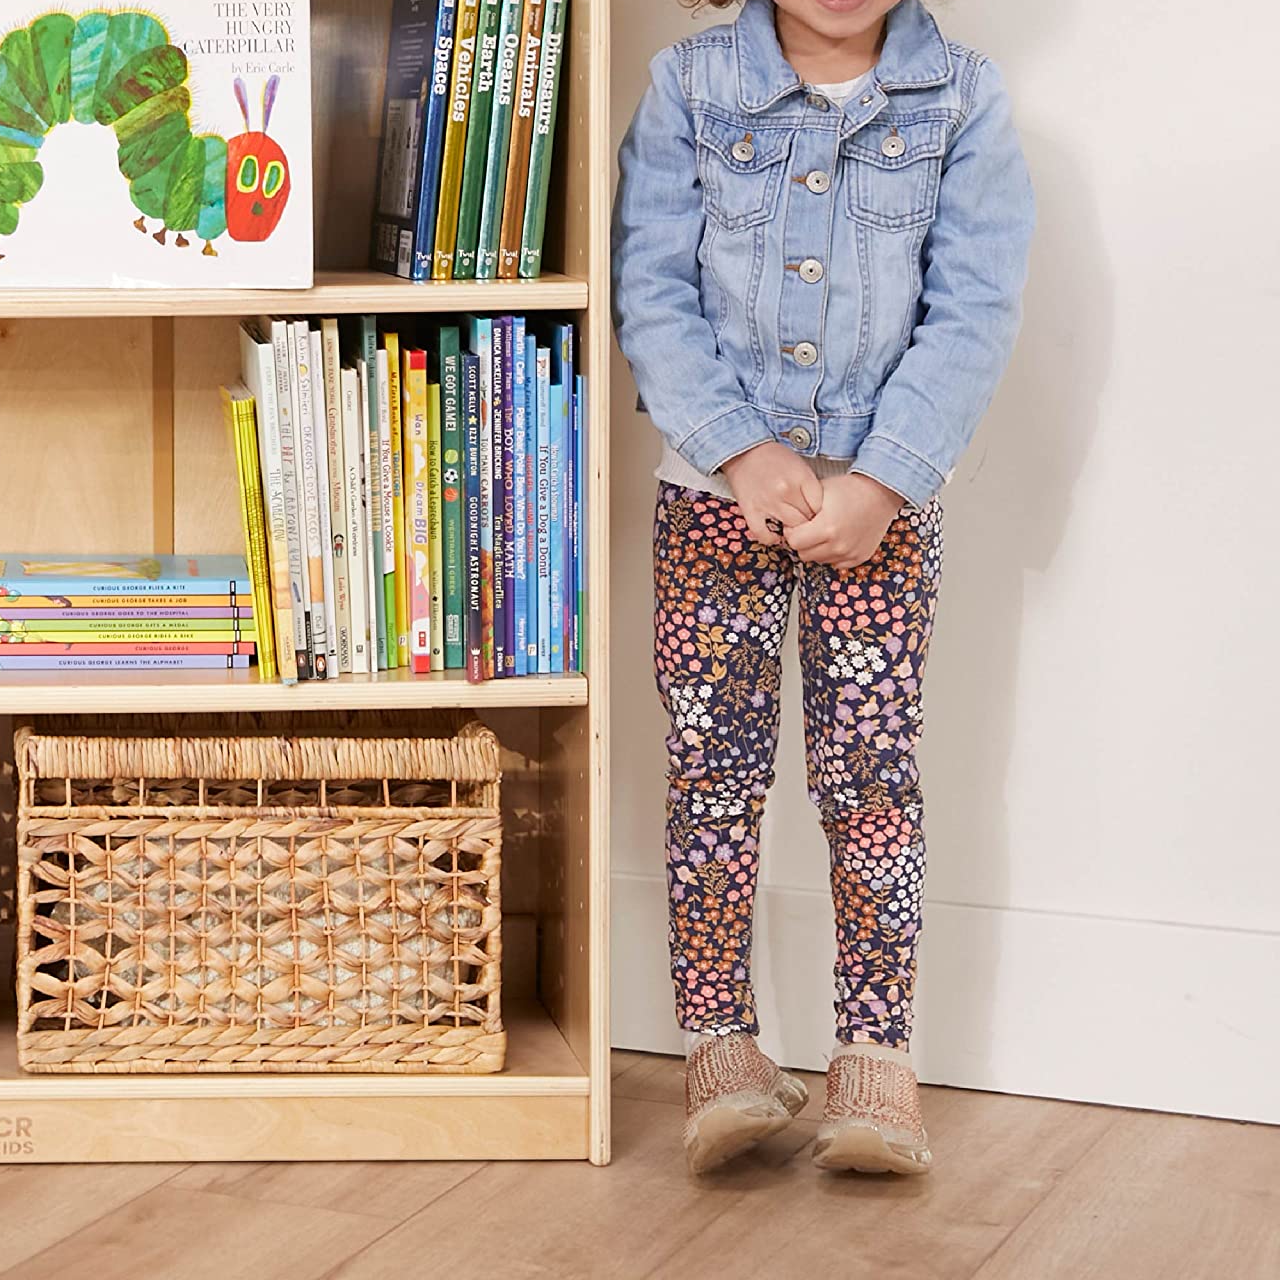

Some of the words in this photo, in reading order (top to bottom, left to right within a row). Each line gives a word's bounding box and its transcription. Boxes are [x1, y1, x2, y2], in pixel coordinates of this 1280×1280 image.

[213, 2, 248, 17] THE
[252, 2, 295, 17] VERY
[226, 20, 294, 35] HUNGRY
[183, 38, 295, 54] CATERPILLAR
[231, 62, 242, 74] by
[246, 62, 265, 73] Eric
[268, 62, 295, 73] Carle
[434, 36, 452, 95] Space
[478, 34, 497, 92] Earth
[499, 34, 519, 105] Oceans
[519, 33, 540, 117] Animals
[453, 36, 475, 122] Vehicles
[538, 32, 562, 134] Dinosaurs
[298, 335, 307, 361] Rubin
[493, 328, 502, 355] DANICA
[445, 356, 456, 372] WE
[468, 365, 477, 389] SCOTT
[301, 378, 310, 415] Salmieri
[445, 375, 456, 396] GOT
[445, 398, 456, 432] GAME!
[468, 391, 477, 413] KELLY
[415, 414, 423, 436] Wan
[469, 427, 477, 445] IZZY
[494, 409, 502, 444] JENNIFER
[305, 426, 315, 470] DRAGONS
[430, 440, 438, 456] How
[504, 428, 513, 454] BOY
[382, 447, 390, 463] You
[430, 457, 437, 466] to
[469, 448, 477, 476] BURTON
[481, 455, 489, 475] MANY
[494, 446, 502, 479] BRICKING
[539, 457, 549, 475] You
[273, 469, 282, 488] THE
[383, 466, 391, 482] Give
[429, 468, 439, 489] Catch
[504, 459, 512, 490] WHO
[307, 476, 316, 502] LOVE
[416, 482, 424, 516] Dream
[539, 479, 549, 503] Give
[271, 491, 285, 542] SCARECROW
[383, 491, 392, 516] Mouse
[481, 479, 489, 528] CARROTS
[504, 496, 513, 533] LOVED
[308, 507, 318, 541] TACOS
[428, 496, 439, 539] Leprechaun
[469, 496, 479, 551] GOODNIGHT
[495, 515, 503, 531] Ten
[538, 514, 548, 534] Dog
[385, 526, 393, 552] Cookie
[414, 518, 427, 544] BIG
[494, 533, 503, 555] Magic
[504, 541, 514, 578] MATH
[540, 547, 548, 578] Donut
[470, 555, 479, 611] ASTRONAUT
[495, 557, 503, 608] Butterflies
